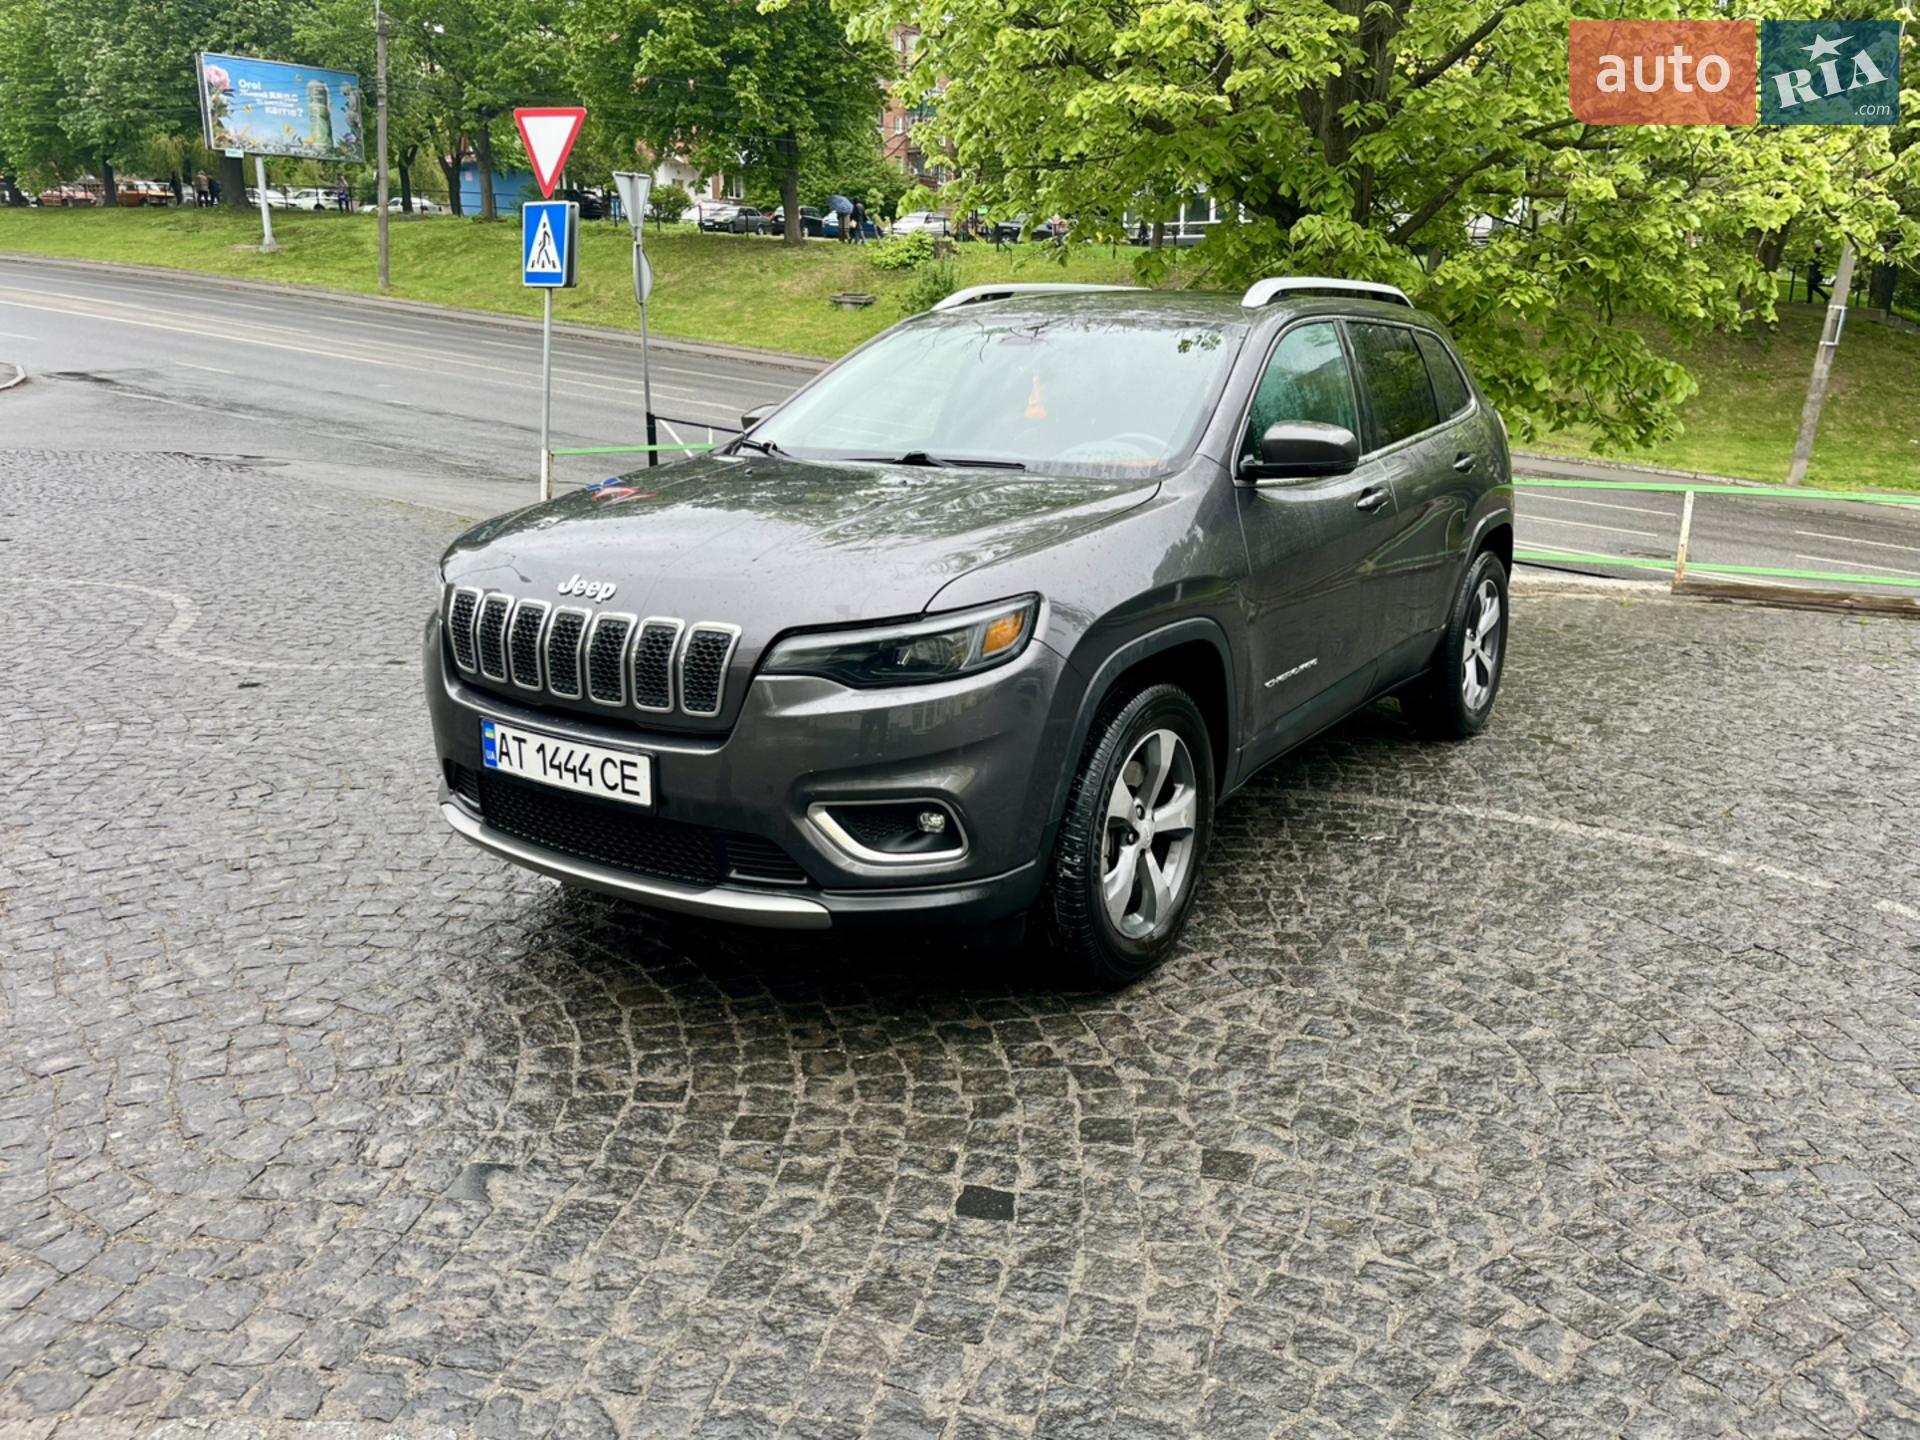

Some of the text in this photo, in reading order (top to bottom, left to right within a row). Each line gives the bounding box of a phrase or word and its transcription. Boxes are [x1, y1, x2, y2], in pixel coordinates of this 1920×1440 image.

[557, 574, 617, 604] Jeep
[486, 749, 497, 761] UA
[498, 732, 641, 796] AT 1444 CE
